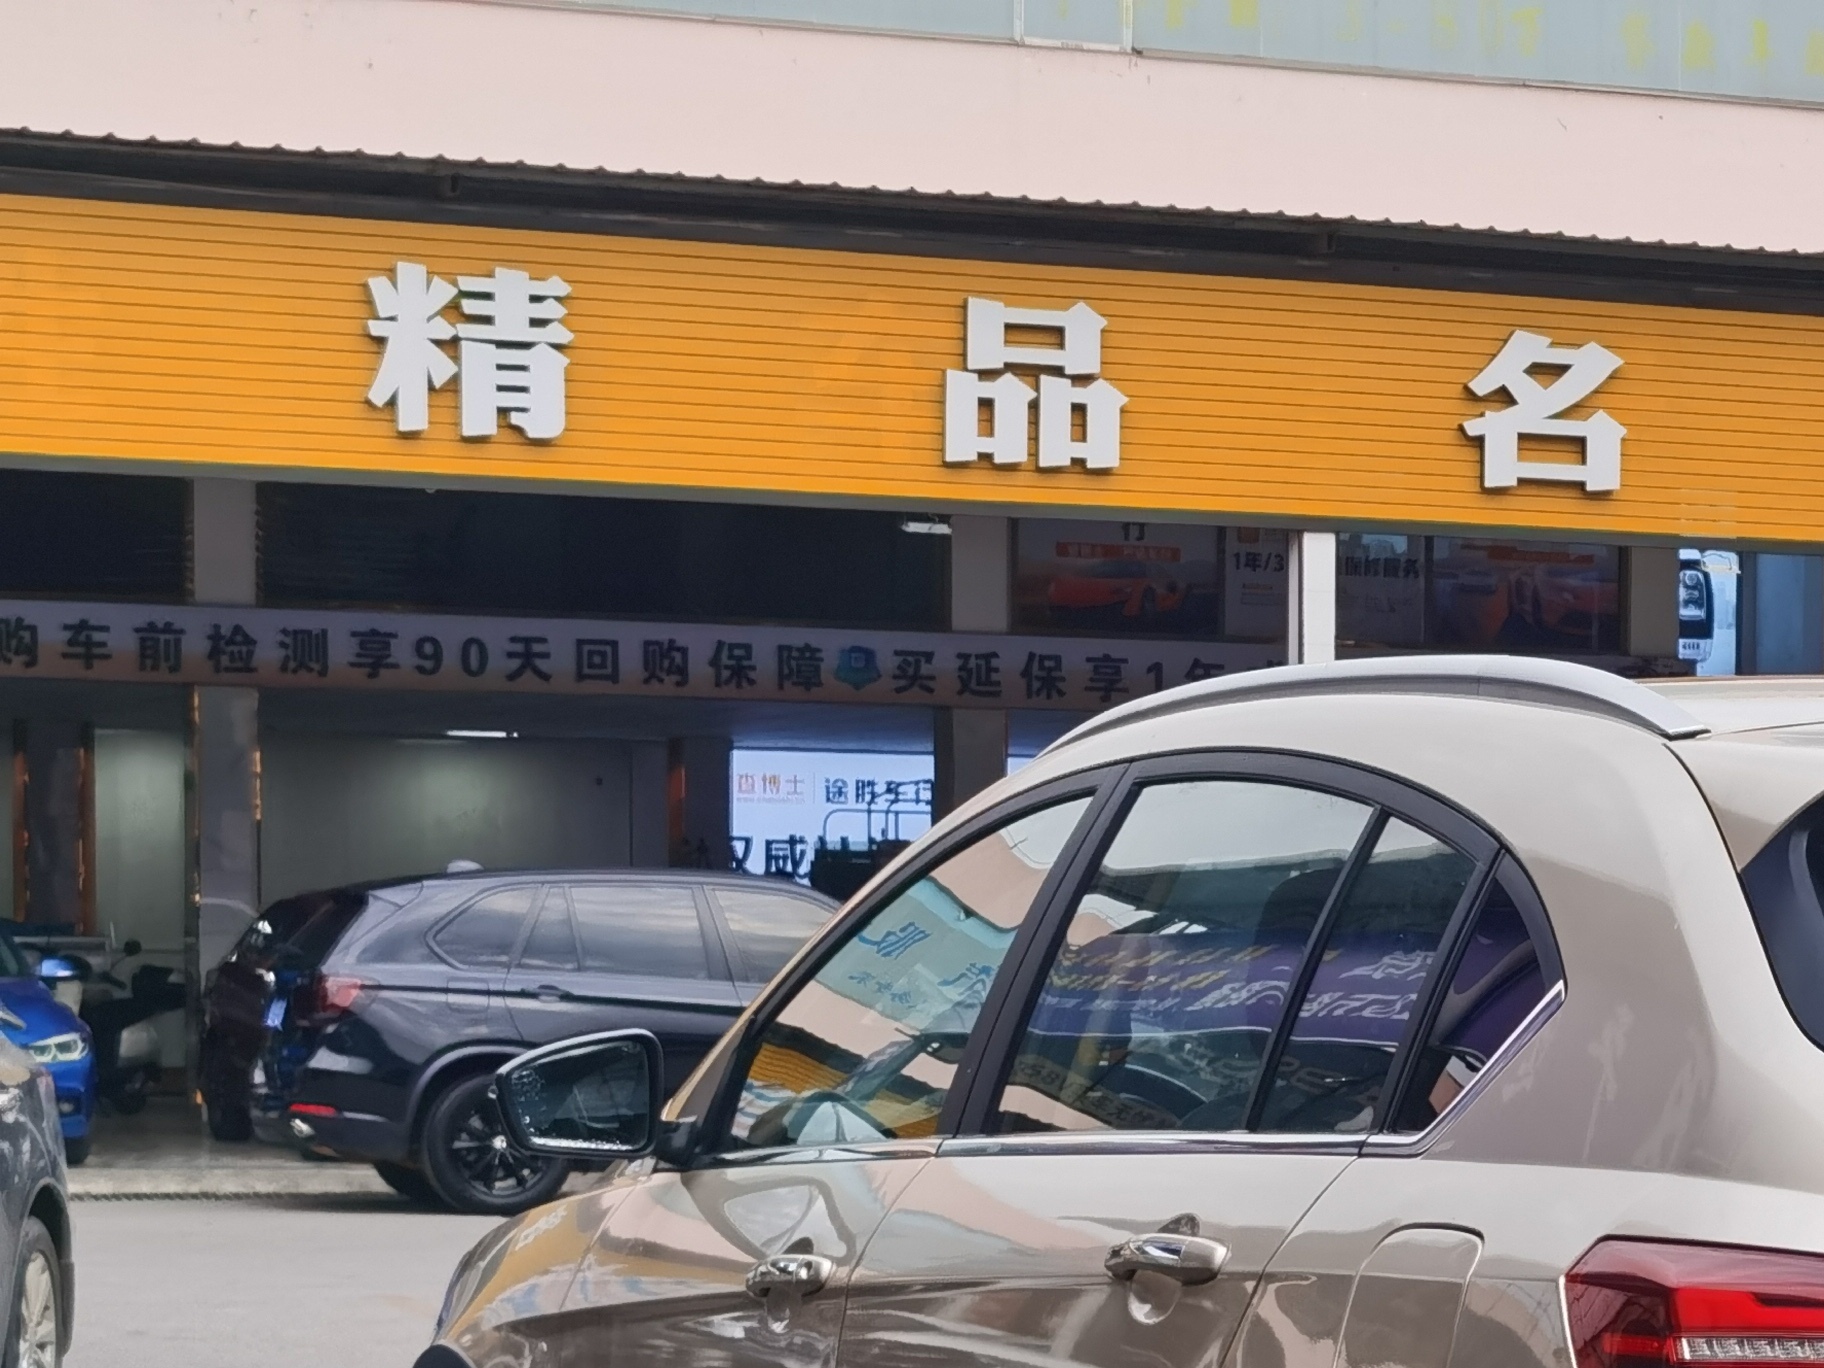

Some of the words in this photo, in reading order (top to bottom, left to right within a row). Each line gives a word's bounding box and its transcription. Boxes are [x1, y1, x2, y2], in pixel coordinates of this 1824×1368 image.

[0, 615, 824, 692] 购车前检测享90天回购保障
[893, 649, 1284, 698] 买延保享1
